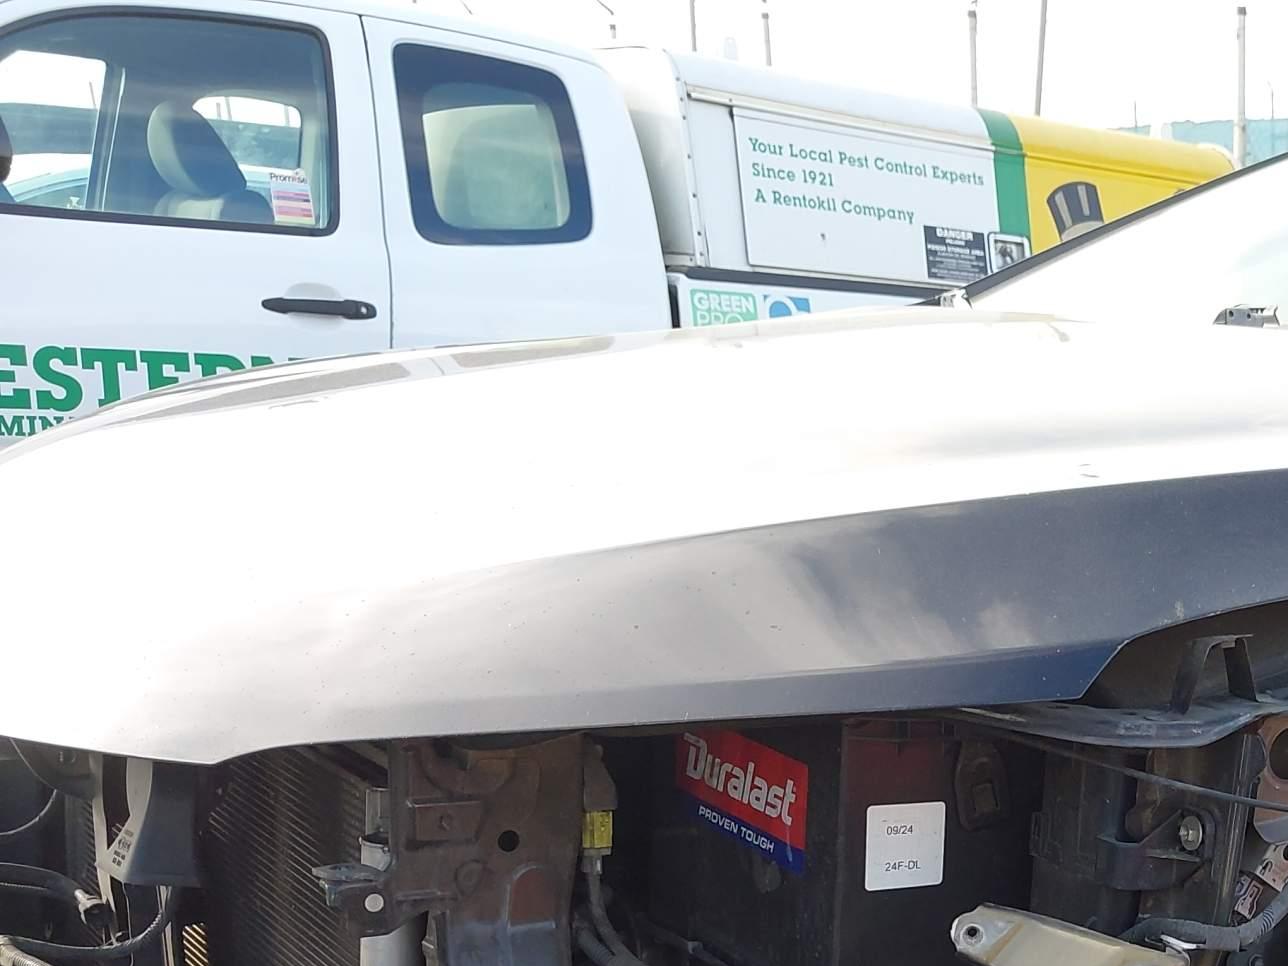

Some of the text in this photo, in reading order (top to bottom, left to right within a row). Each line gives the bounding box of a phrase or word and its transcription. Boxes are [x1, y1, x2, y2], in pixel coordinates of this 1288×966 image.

[748, 137, 985, 187] Your Local Pest Control Experts
[752, 162, 834, 188] Since 1921
[754, 188, 915, 225] A Rentokil Company
[935, 227, 974, 241] DANGER
[693, 292, 755, 315] GREEN
[683, 732, 797, 826] Duralast
[698, 805, 775, 853] PROVEN TOUGH
[886, 824, 914, 837] 09/24
[885, 860, 921, 873] 24F-DL
